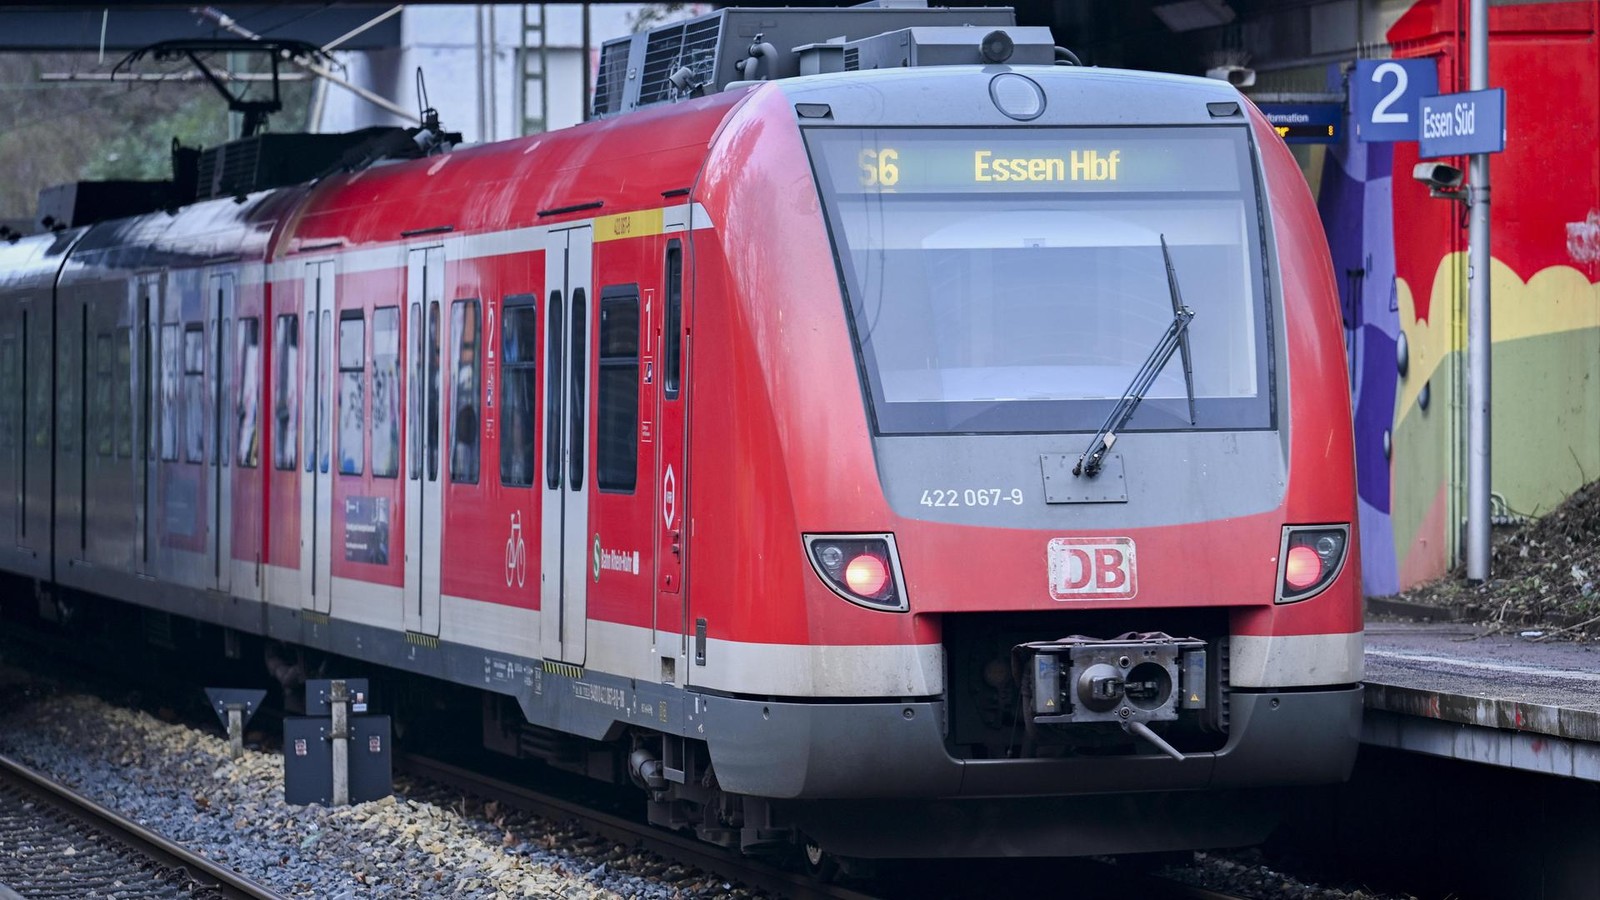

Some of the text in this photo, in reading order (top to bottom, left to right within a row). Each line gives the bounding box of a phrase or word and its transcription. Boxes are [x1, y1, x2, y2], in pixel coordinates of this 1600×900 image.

[1371, 62, 1408, 123] 2
[1266, 112, 1309, 123] formation
[1423, 102, 1475, 138] Essen Süd
[858, 148, 1121, 187] S6 Essen Hbf
[488, 307, 494, 359] 2
[920, 488, 1024, 507] 422 067-9
[593, 538, 600, 579] S
[1063, 548, 1126, 590] DB
